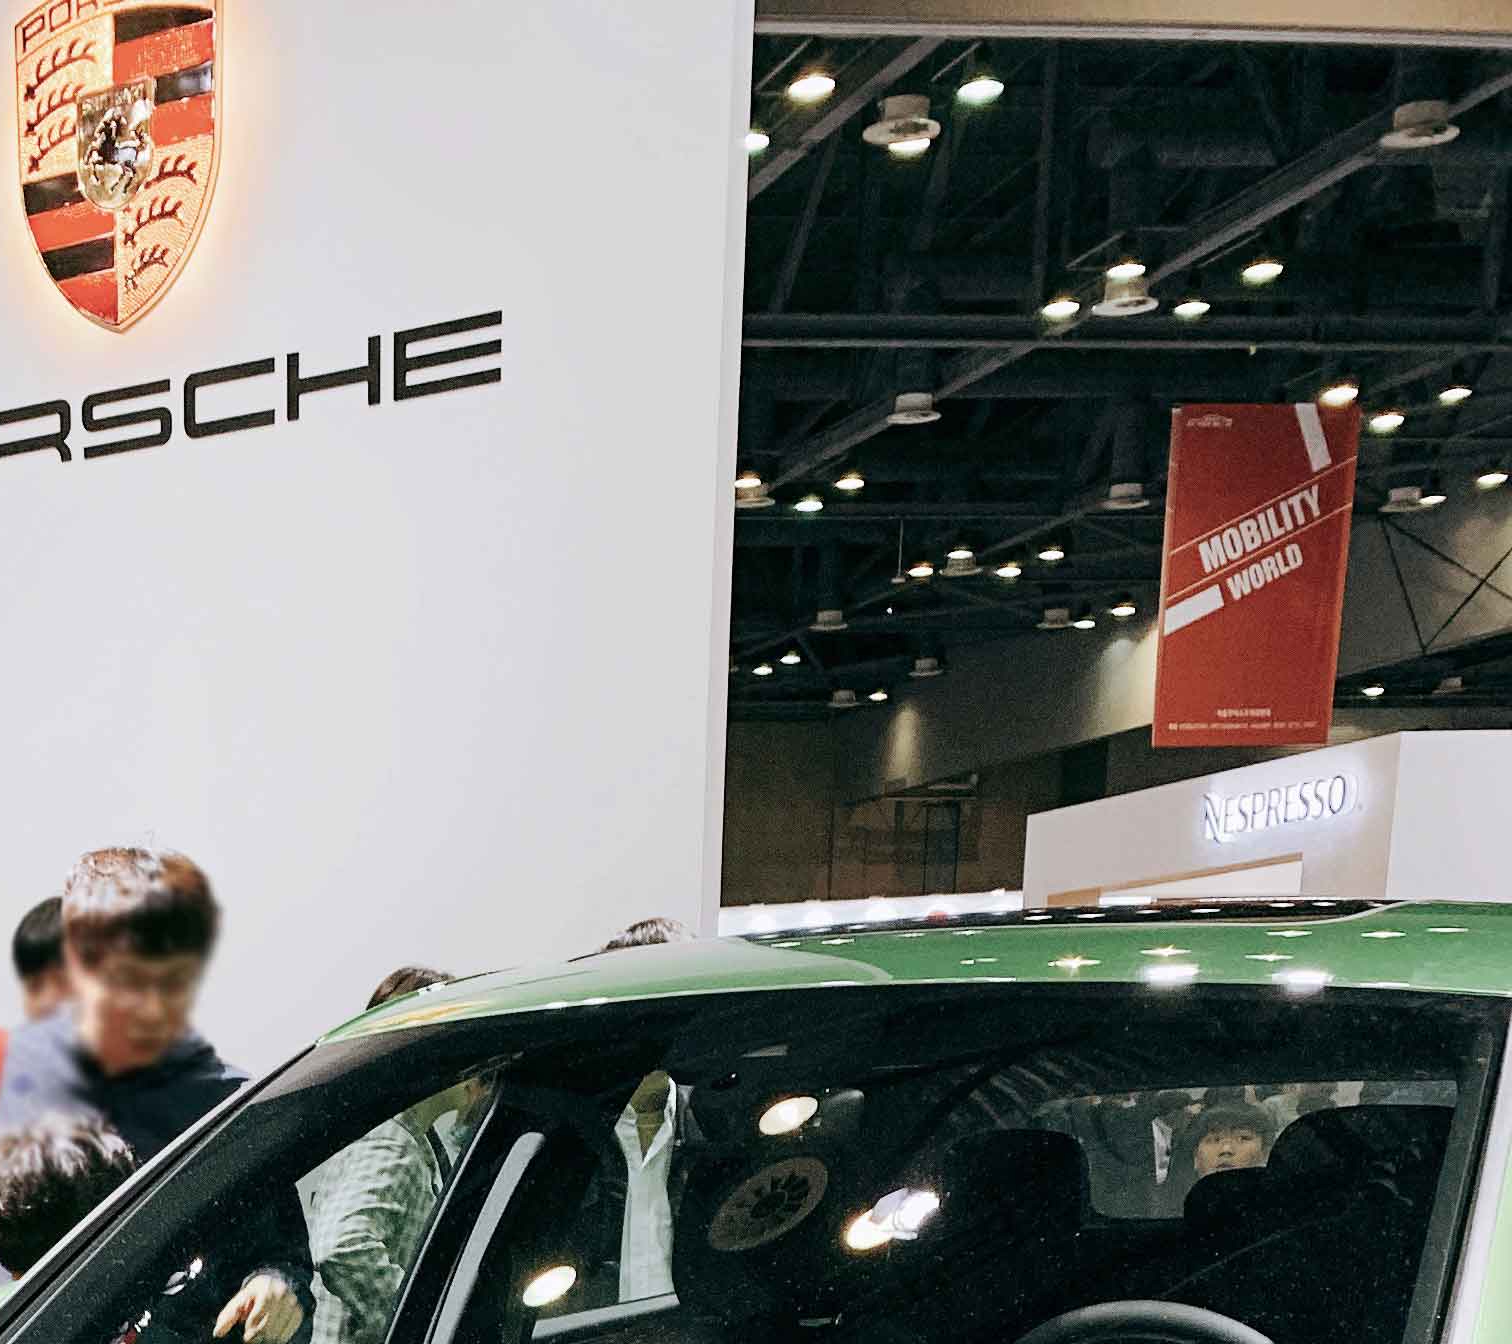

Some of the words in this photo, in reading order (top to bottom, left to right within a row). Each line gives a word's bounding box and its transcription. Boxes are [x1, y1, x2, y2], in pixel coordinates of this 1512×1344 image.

[1198, 484, 1321, 573] MOBILITY
[1227, 543, 1303, 600] WORLD
[1202, 775, 1350, 844] NESPRESSO
